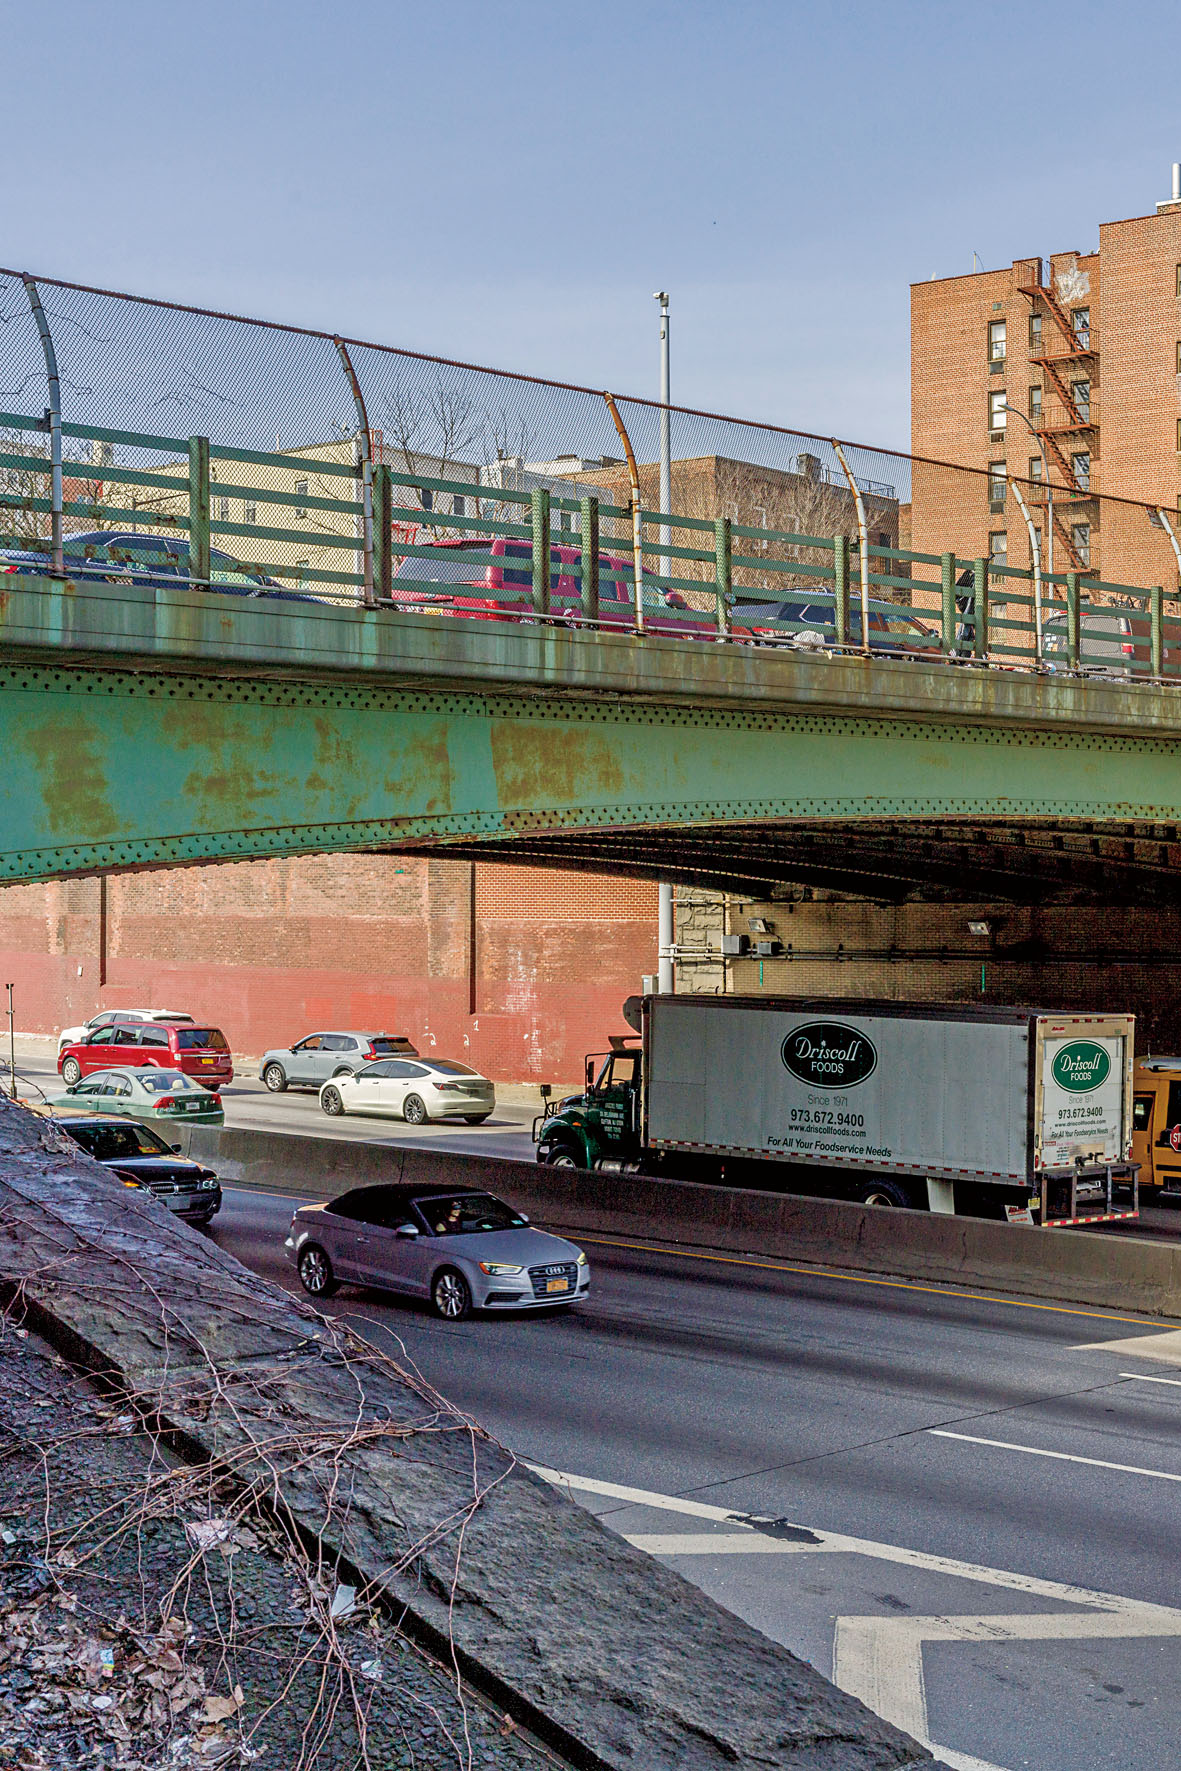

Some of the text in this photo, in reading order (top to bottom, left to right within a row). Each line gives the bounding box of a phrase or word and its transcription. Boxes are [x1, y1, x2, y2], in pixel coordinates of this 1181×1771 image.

[795, 1036, 862, 1061] Driscoll
[811, 1061, 844, 1074] FOODS
[1060, 1053, 1102, 1072] Driscoll
[1070, 1072, 1092, 1081] FOODS
[807, 1093, 848, 1107] Since 1971
[1068, 1095, 1082, 1104] Since
[790, 1108, 864, 1127] 973.672.9400
[1058, 1106, 1103, 1119] 973.672.9400
[788, 1124, 867, 1138] www.driscollfoods.com
[767, 1136, 892, 1158] For All Your Foodservice Needs
